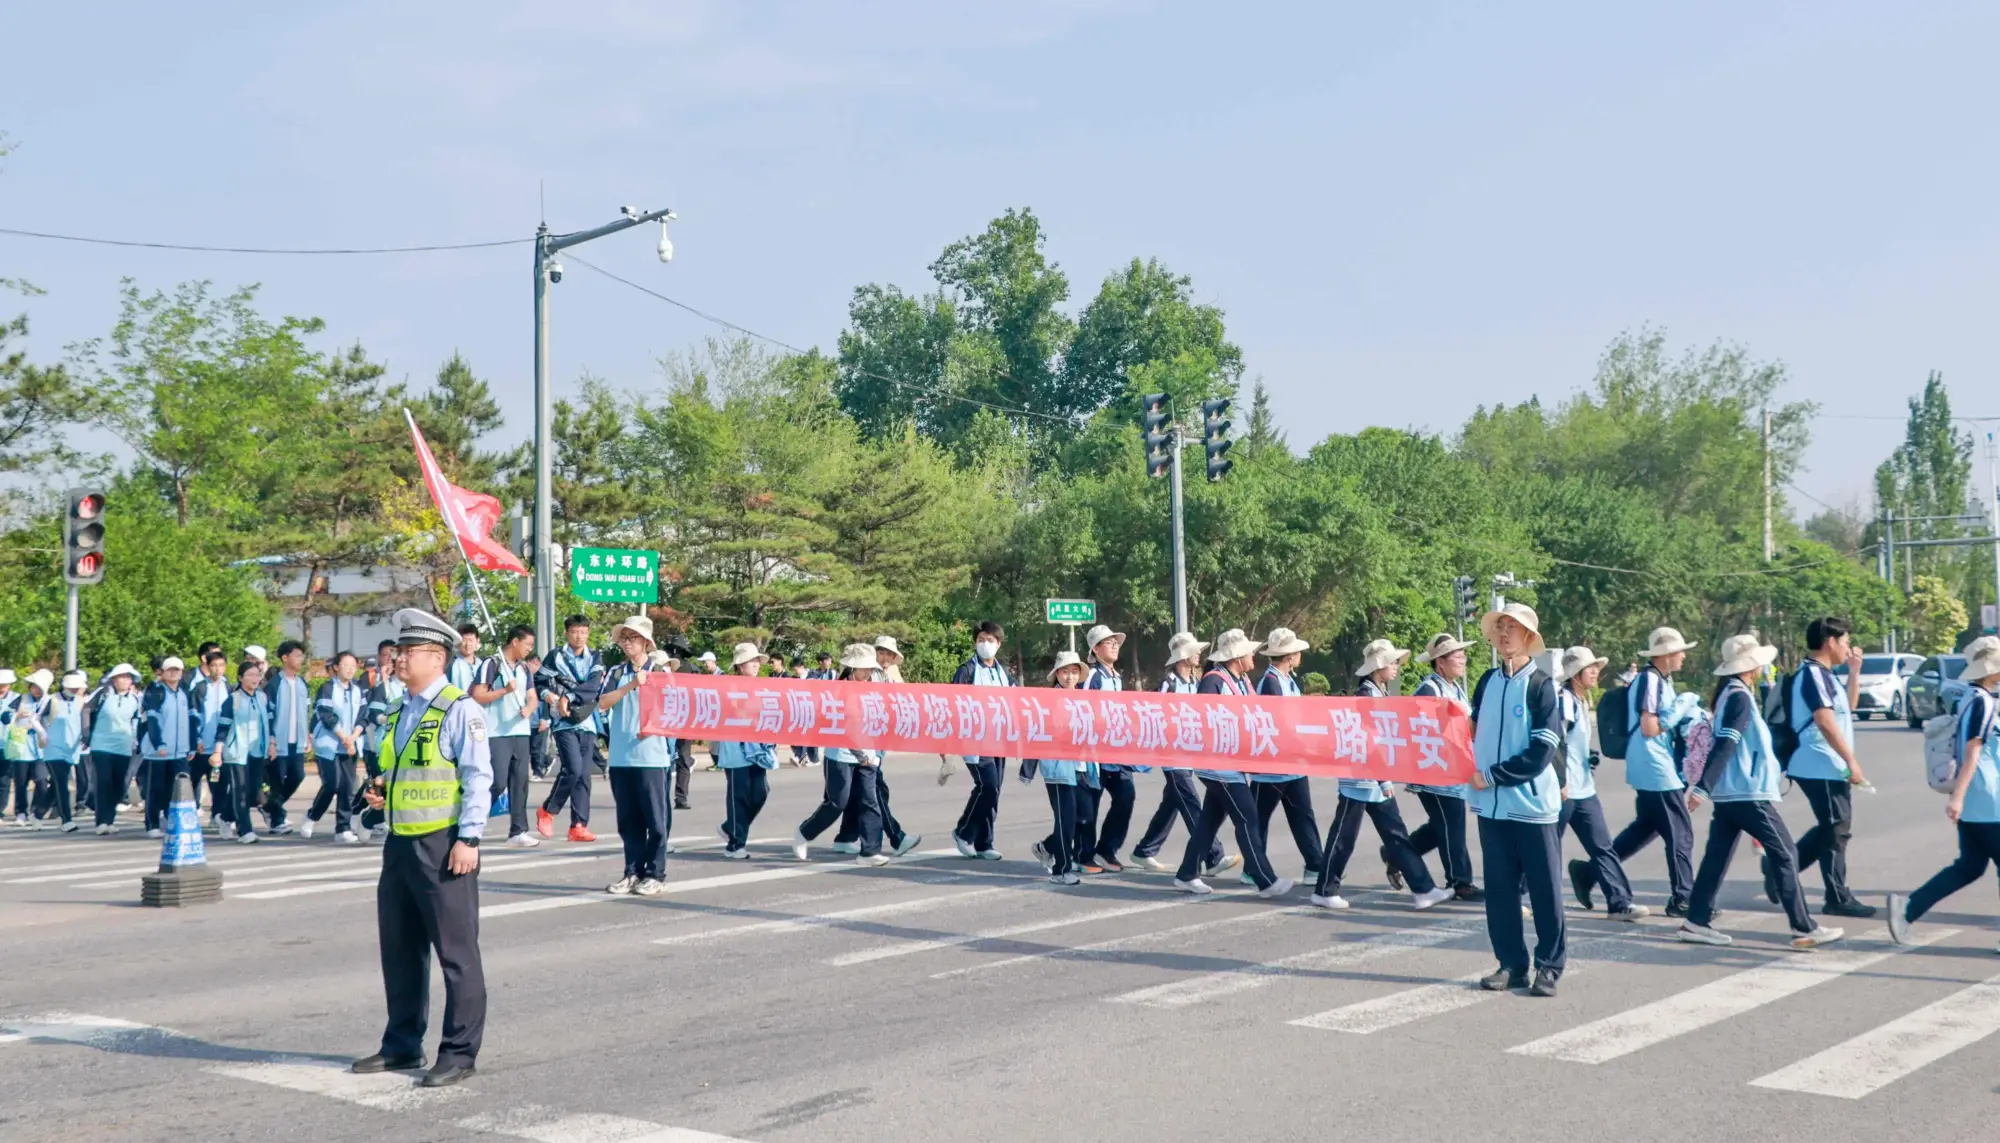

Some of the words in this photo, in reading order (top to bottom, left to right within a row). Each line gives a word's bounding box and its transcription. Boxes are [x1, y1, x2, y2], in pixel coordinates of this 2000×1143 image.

[590, 554, 647, 570] 东外环路
[637, 575, 645, 583] LU
[659, 684, 845, 735] 朝阳二高师生
[861, 690, 1053, 743] 感谢您的礼让
[1066, 698, 1279, 757] 祝您旅途愉快
[1296, 708, 1449, 771] 一路平安
[402, 788, 448, 801] POLICE
